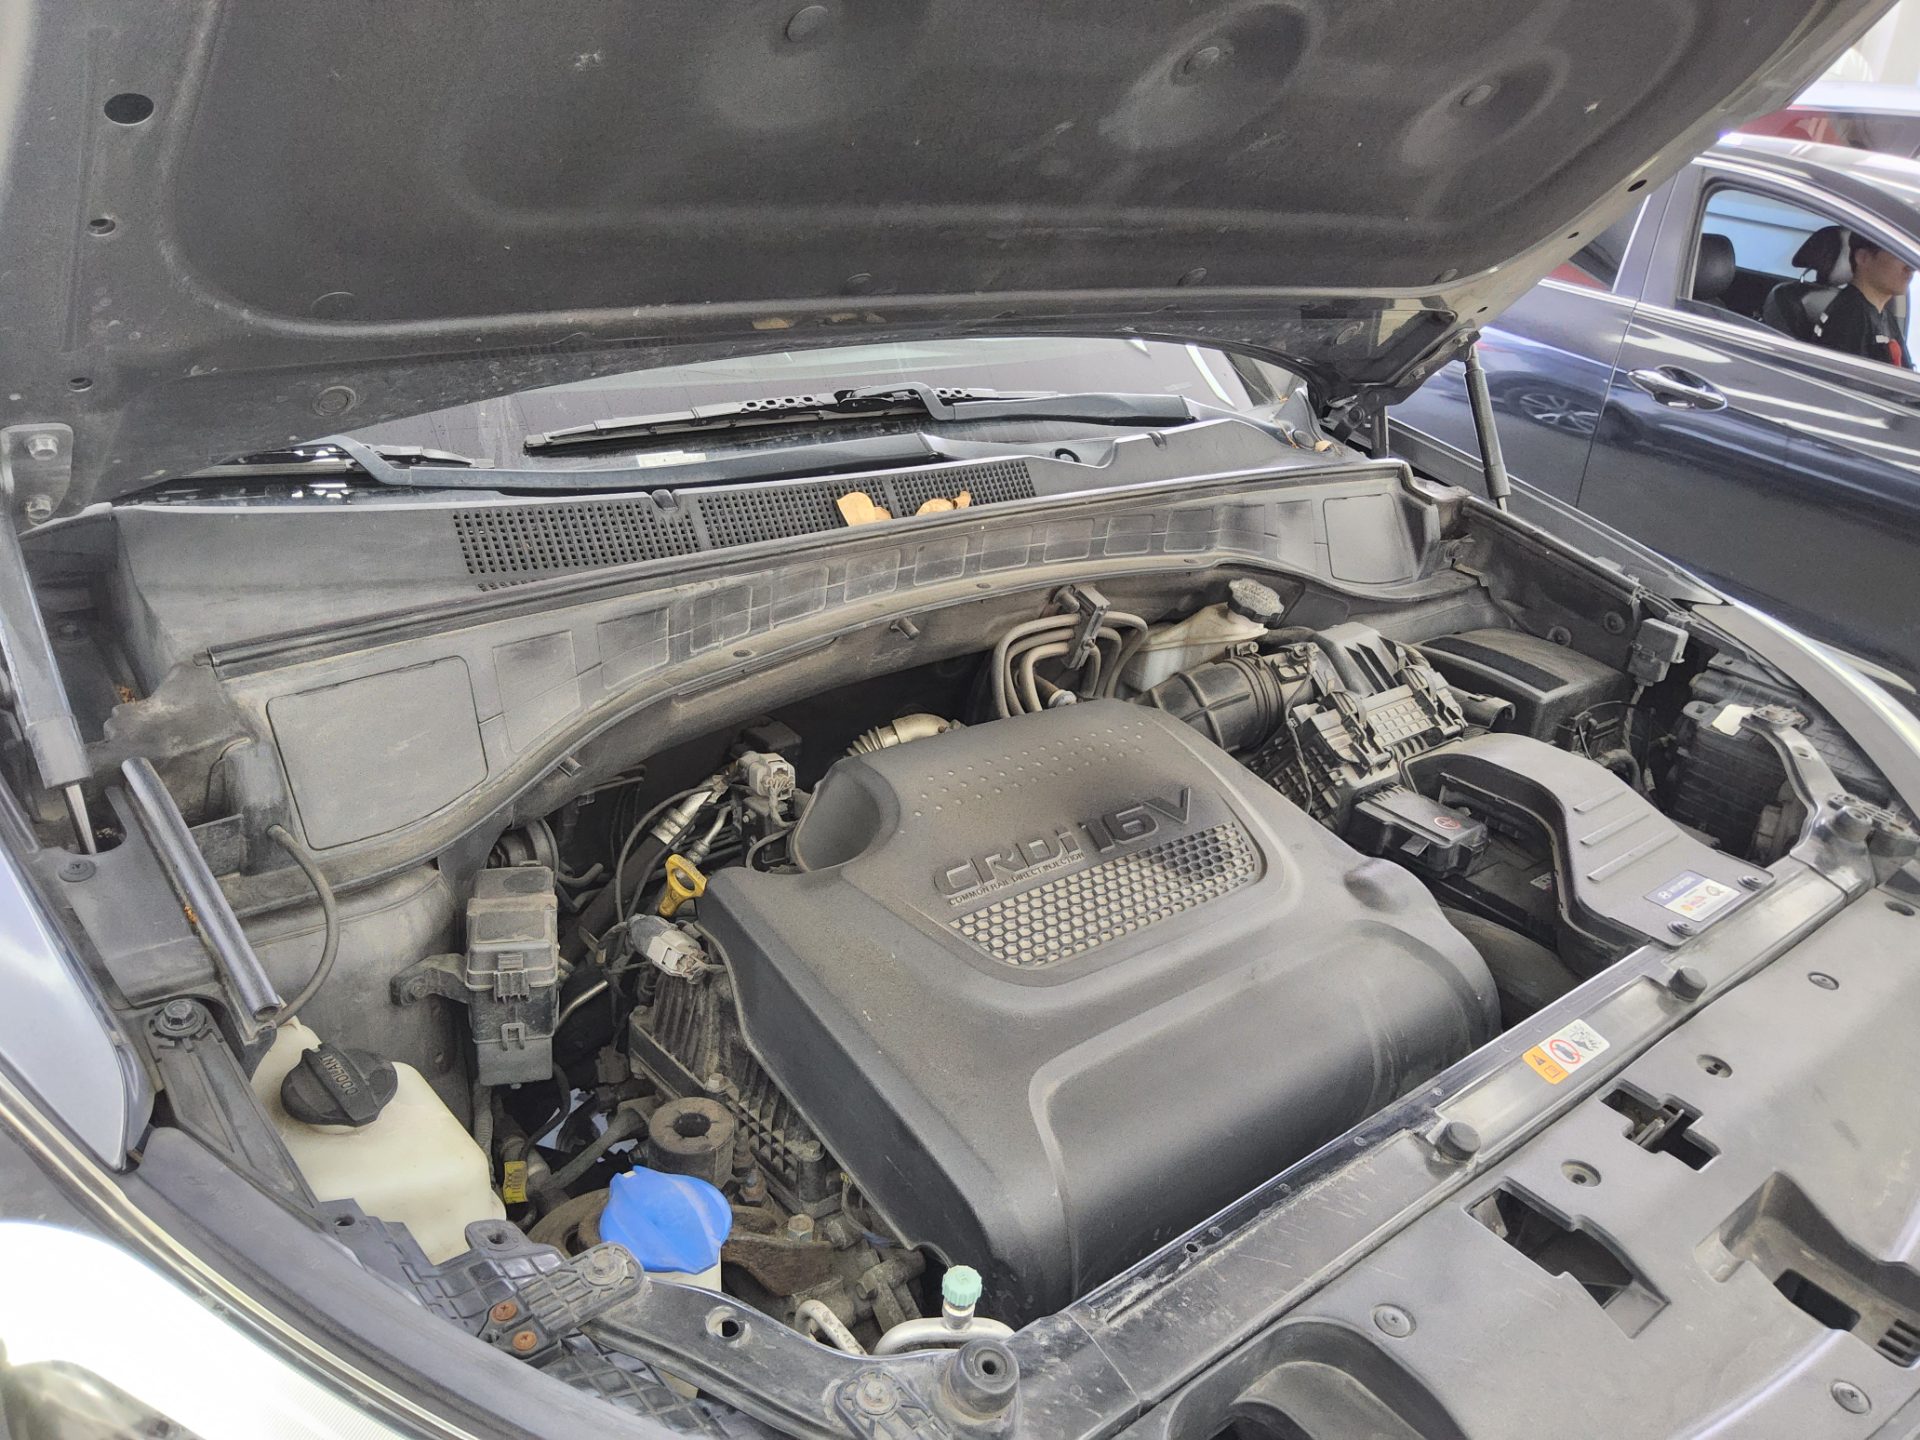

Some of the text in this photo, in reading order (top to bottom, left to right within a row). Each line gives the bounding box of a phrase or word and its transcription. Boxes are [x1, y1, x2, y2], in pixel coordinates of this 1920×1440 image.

[1078, 785, 1191, 853] 16V
[949, 851, 1086, 906] COMMON RAIL DIRECT INJECTION
[319, 1054, 358, 1096] COOLANT
